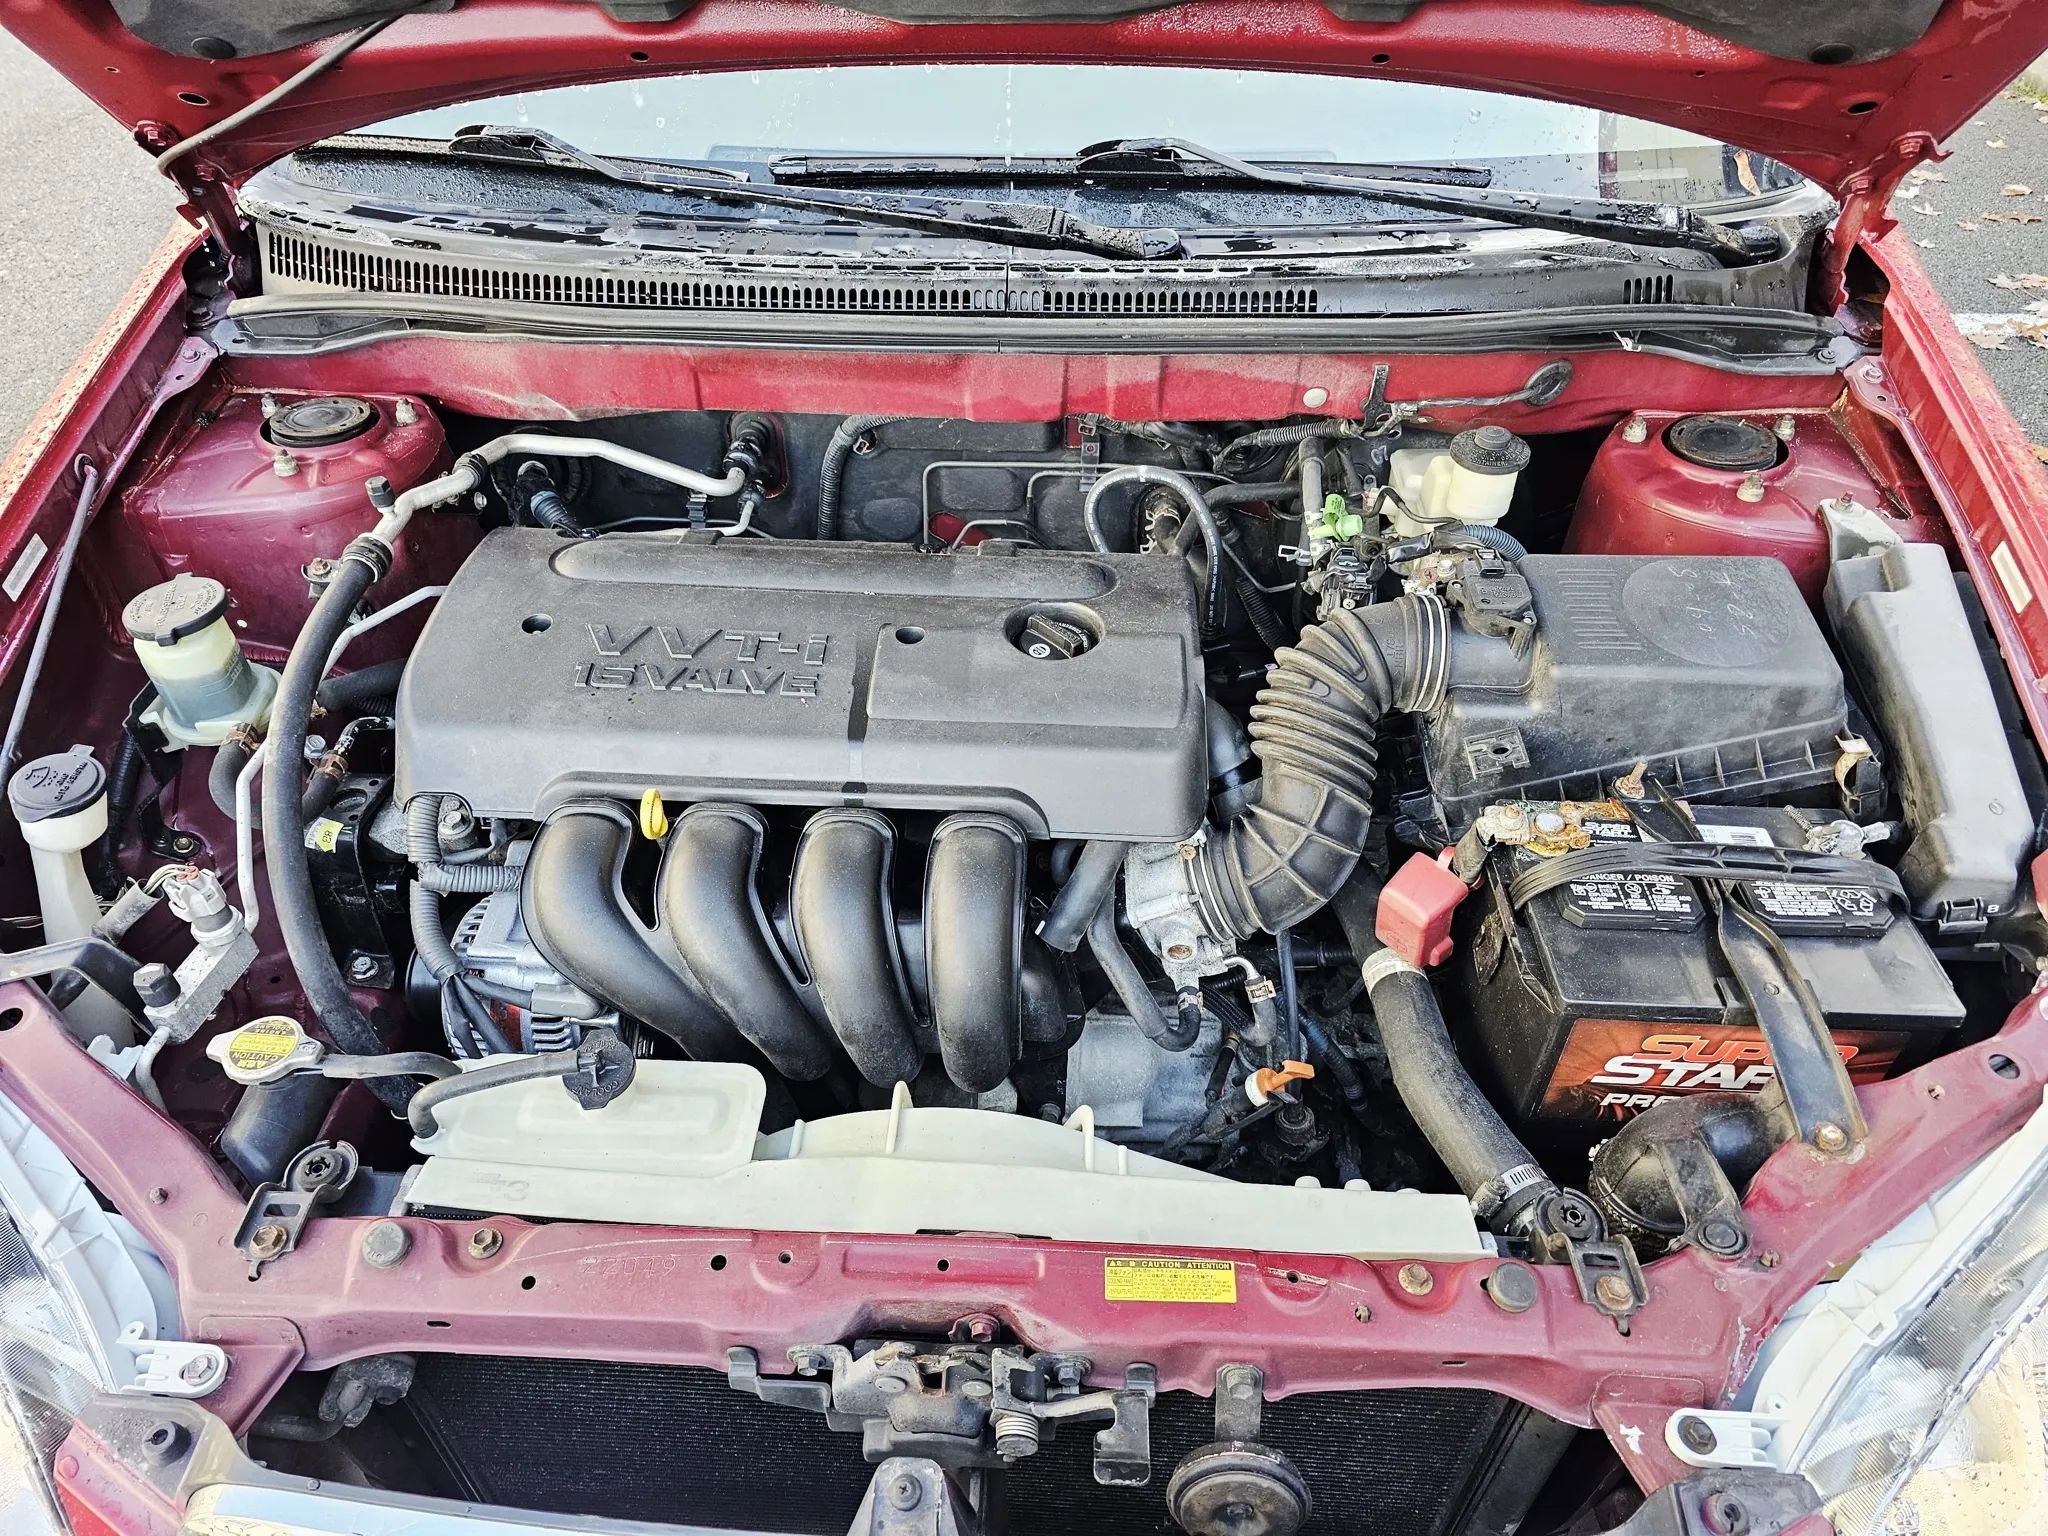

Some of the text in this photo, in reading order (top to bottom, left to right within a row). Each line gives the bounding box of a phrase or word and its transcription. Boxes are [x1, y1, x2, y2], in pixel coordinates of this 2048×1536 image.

[1634, 874, 1674, 882] POISON
[1141, 1261, 1181, 1269] CAUTION
[1186, 1261, 1230, 1270] ATTENTION
